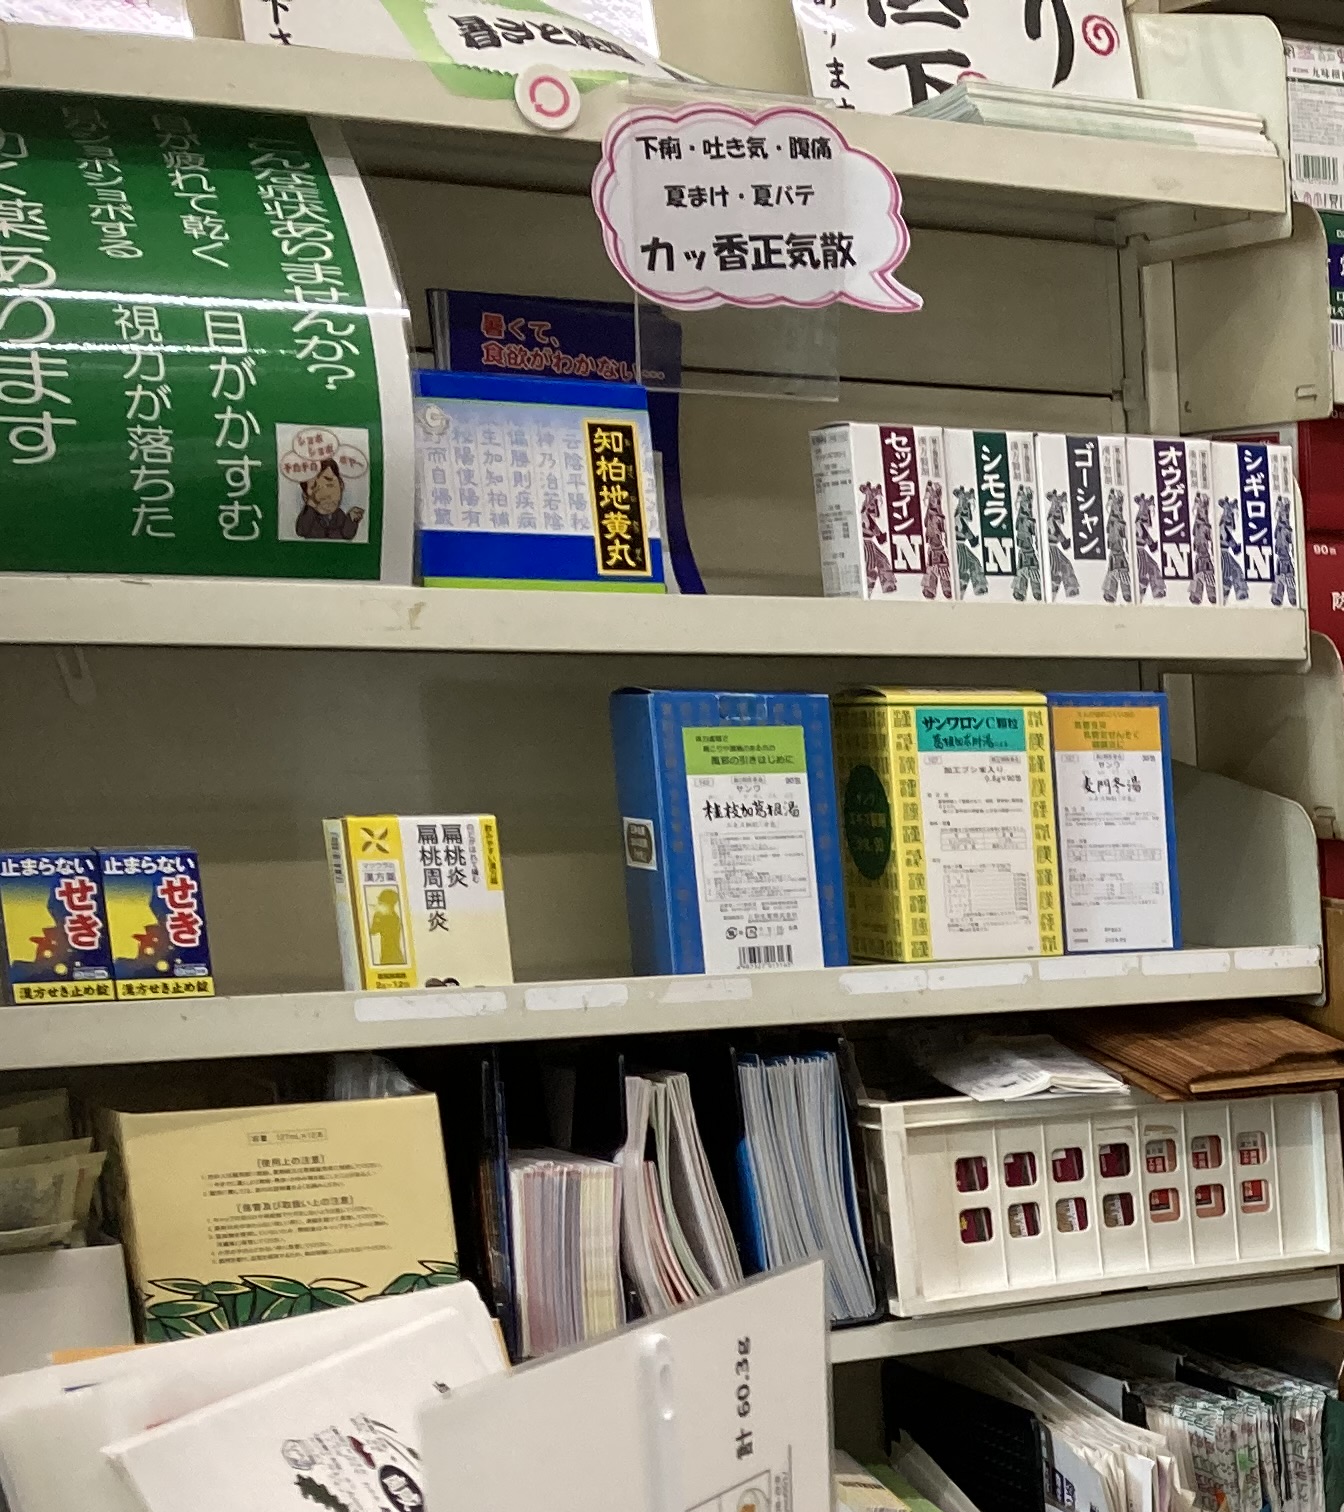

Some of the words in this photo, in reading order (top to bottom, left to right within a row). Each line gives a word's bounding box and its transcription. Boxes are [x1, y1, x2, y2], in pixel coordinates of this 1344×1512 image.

[635, 134, 833, 161] 下痢・吐き気・腹痛
[664, 184, 816, 209] 夏まけ・夏バテ
[640, 232, 857, 273] カッ香正気散
[112, 304, 176, 540] 視力が落ちた
[203, 309, 262, 544] 目がかすむ
[594, 427, 636, 568] 知柏地黄丸
[885, 432, 916, 532] セッショイン
[893, 536, 922, 571] N
[984, 538, 1013, 573] N
[1163, 544, 1191, 575] N
[1246, 545, 1272, 579] N
[0, 856, 94, 876] 止まらない
[103, 855, 196, 876] 止まらない
[441, 823, 468, 889] 扁桃炎
[416, 823, 449, 933] 扁桃周囲炎
[56, 876, 102, 951] せき
[158, 875, 201, 949] せき
